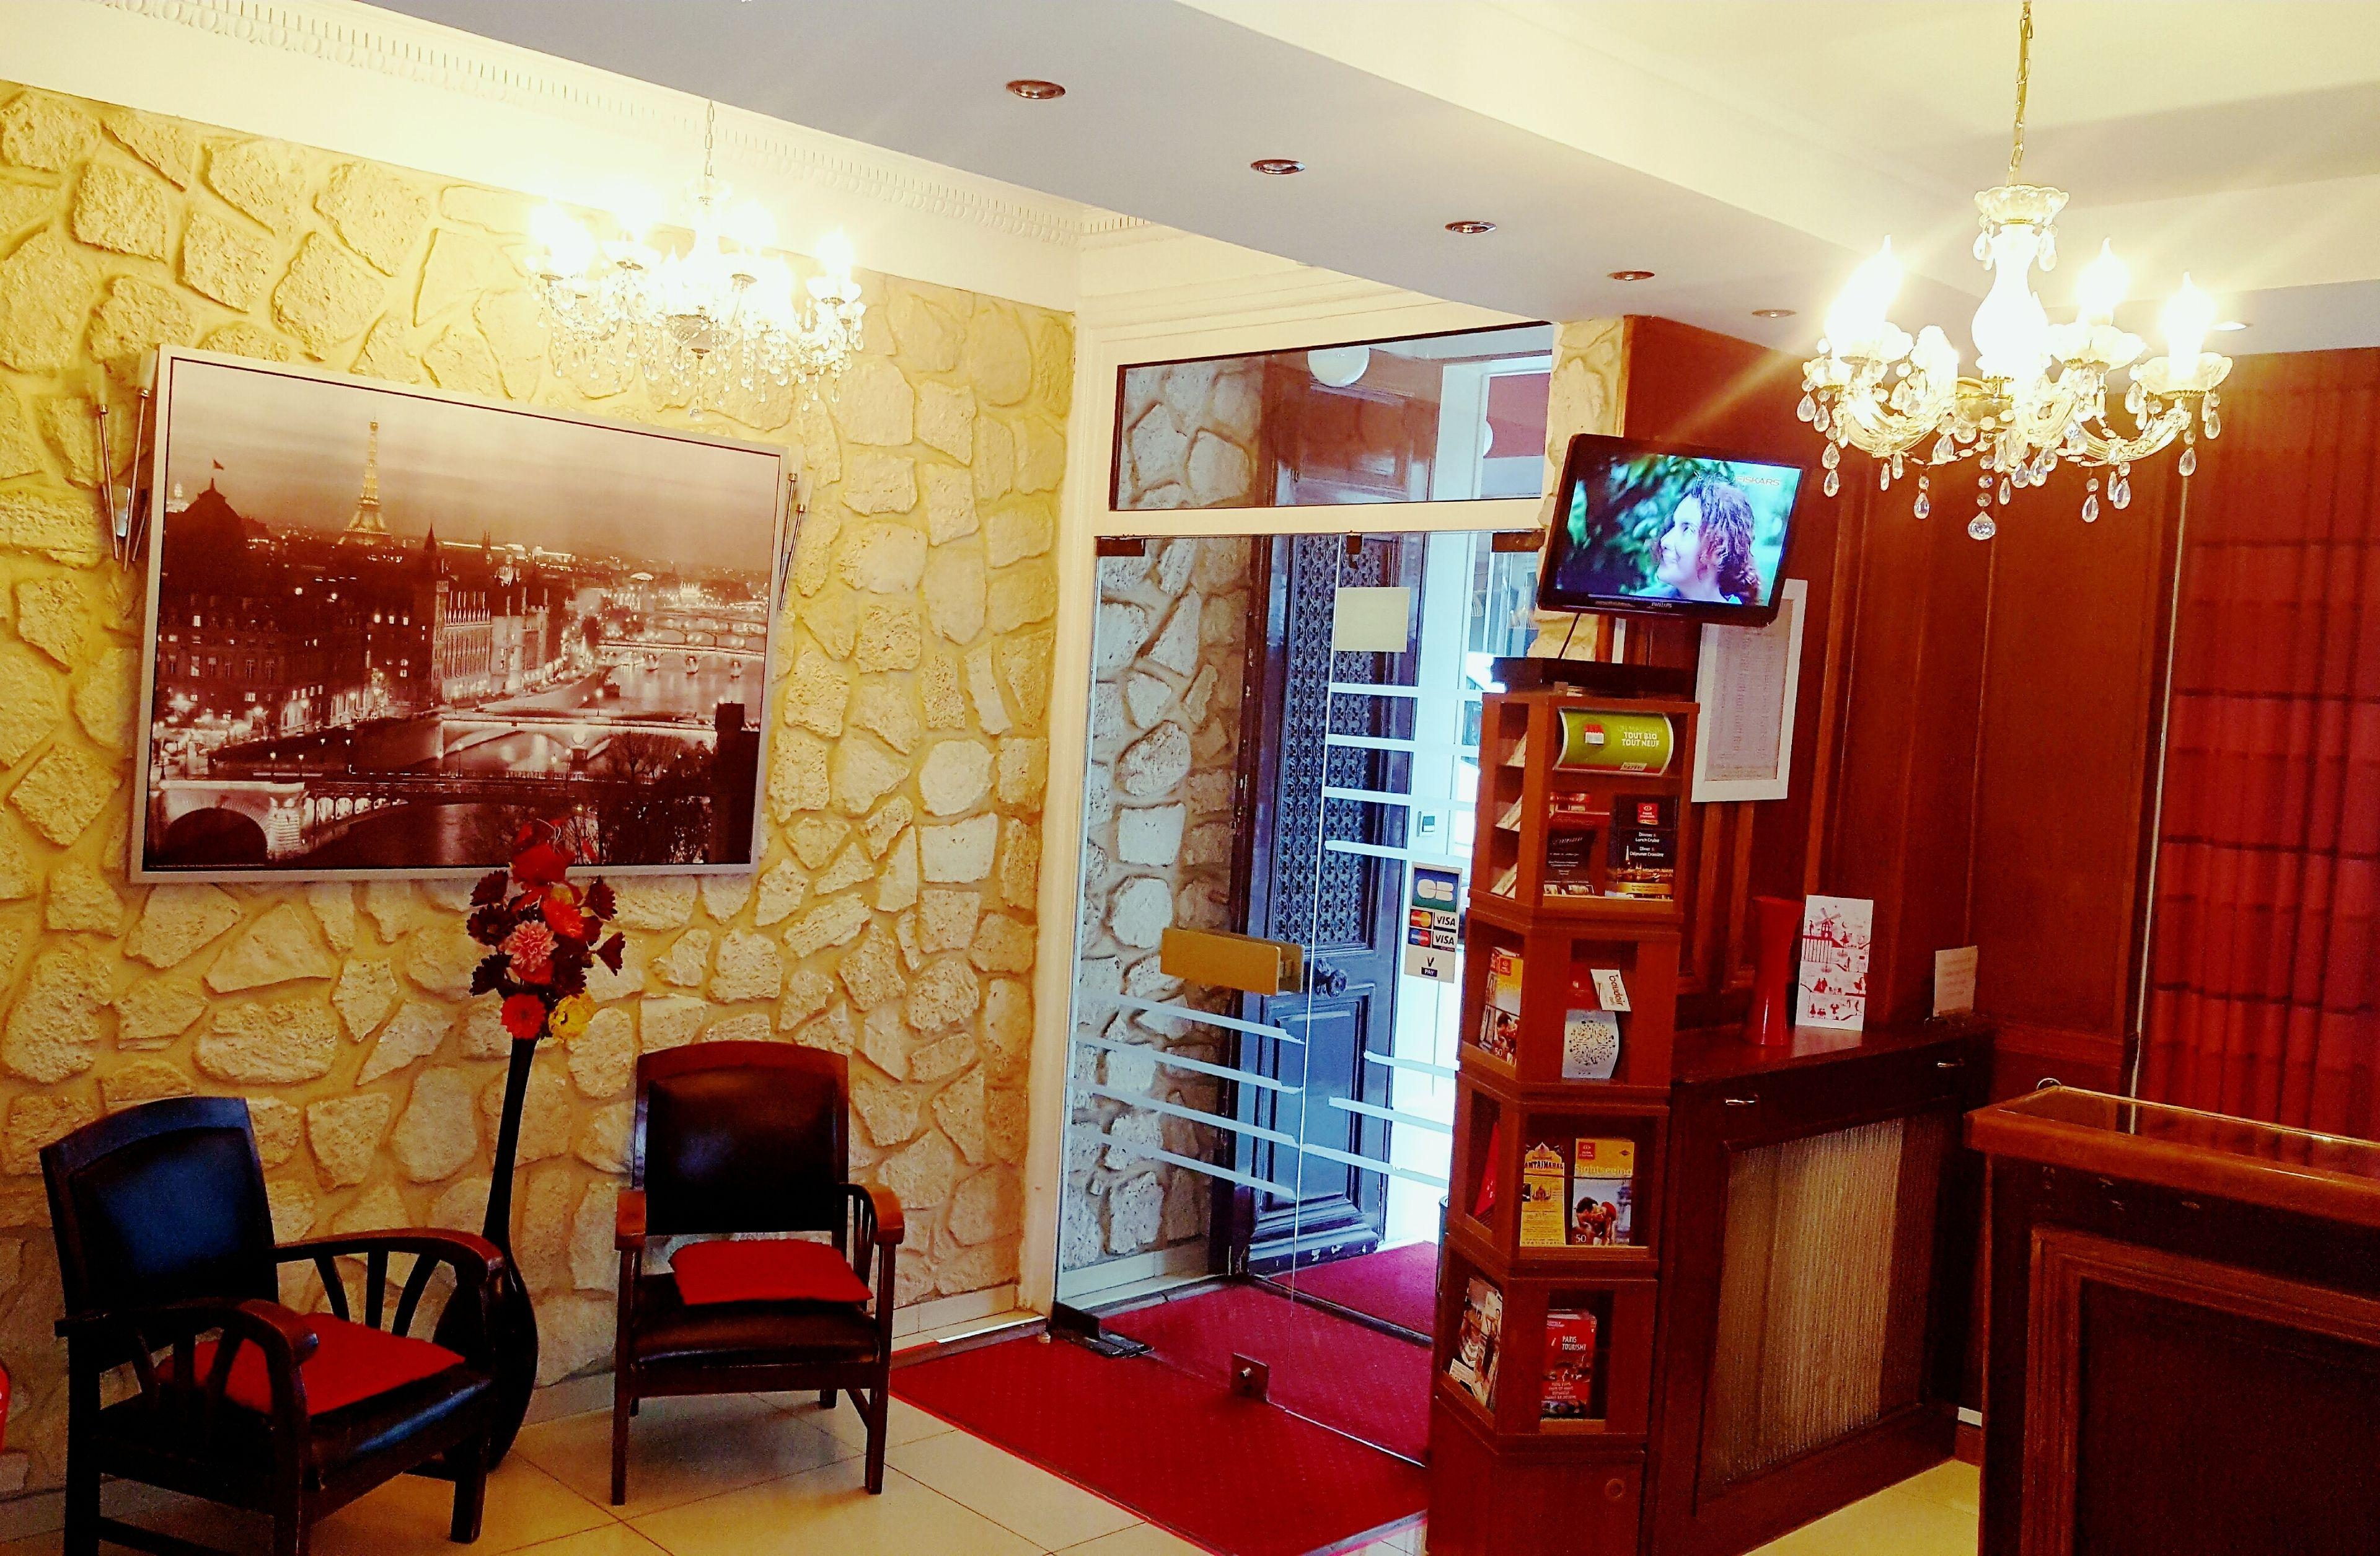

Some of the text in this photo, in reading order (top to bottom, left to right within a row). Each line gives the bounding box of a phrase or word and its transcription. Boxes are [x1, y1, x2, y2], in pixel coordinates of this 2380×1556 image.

[1737, 475, 1781, 486] FISKARS
[1624, 731, 1642, 739] TOUT
[1622, 739, 1660, 747] TOUT NEUF
[1436, 916, 1455, 926] VISA
[1435, 934, 1454, 945] VISA
[1427, 956, 1435, 967] V
[1576, 1233, 1587, 1242] 50
[1562, 1335, 1577, 1343] PARIS
